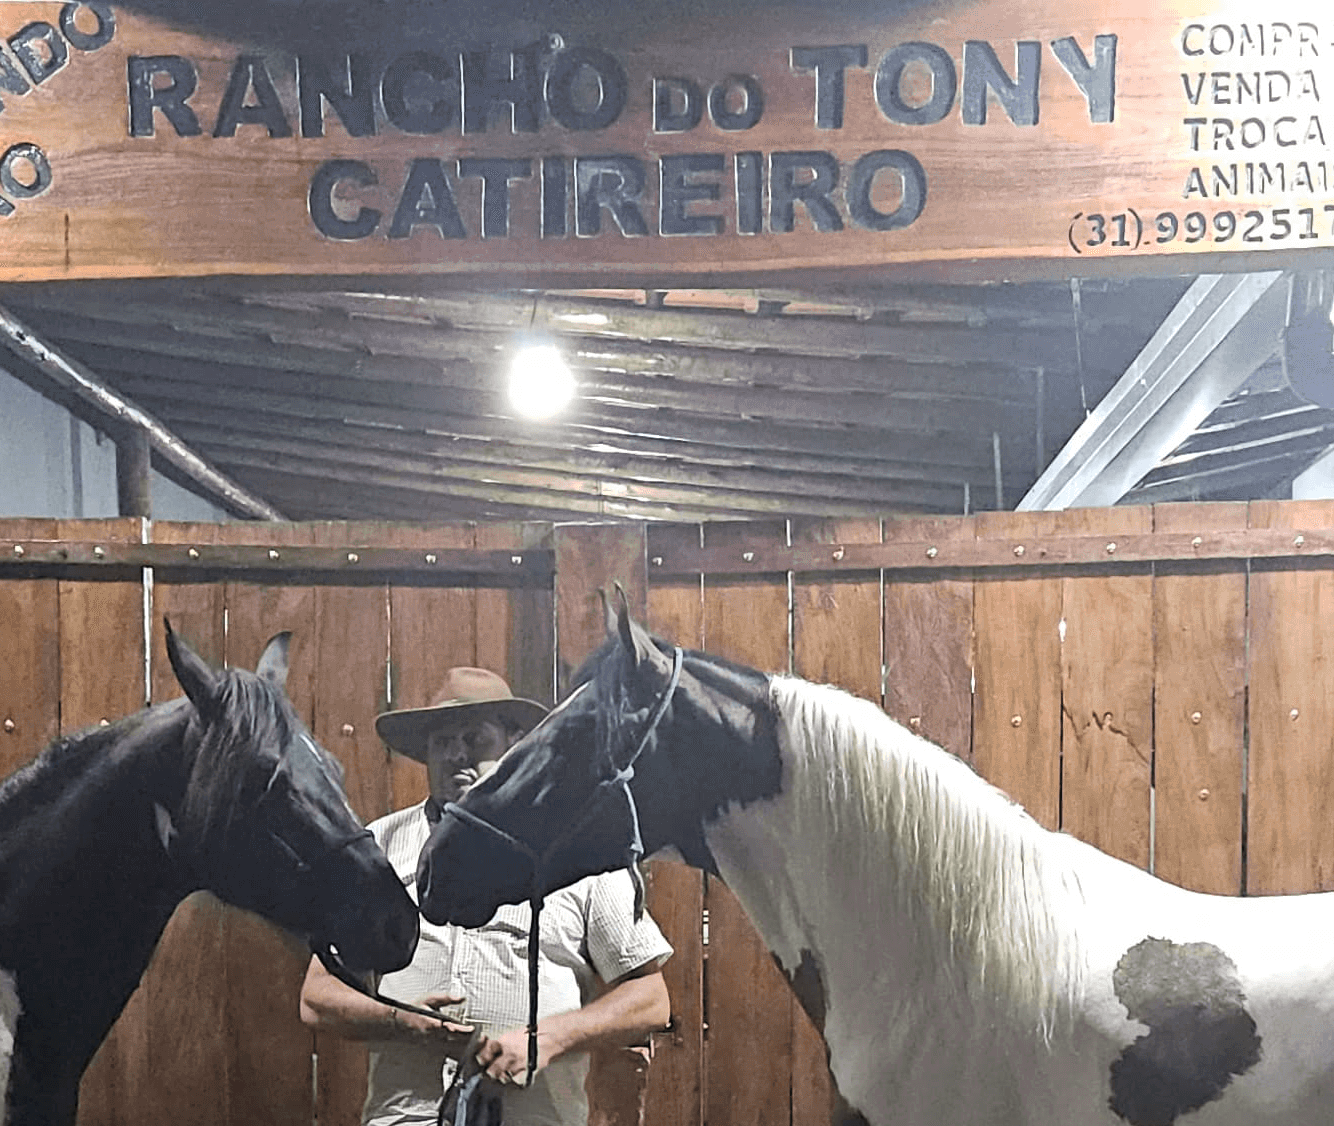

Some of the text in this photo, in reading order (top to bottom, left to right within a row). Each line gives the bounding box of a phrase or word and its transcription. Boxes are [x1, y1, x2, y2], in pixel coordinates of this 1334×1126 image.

[126, 32, 1119, 139] RANCHO DO TONY
[1180, 70, 1320, 105] VENDA
[1182, 115, 1326, 151] TROCA
[307, 149, 929, 243] CATIREIRO
